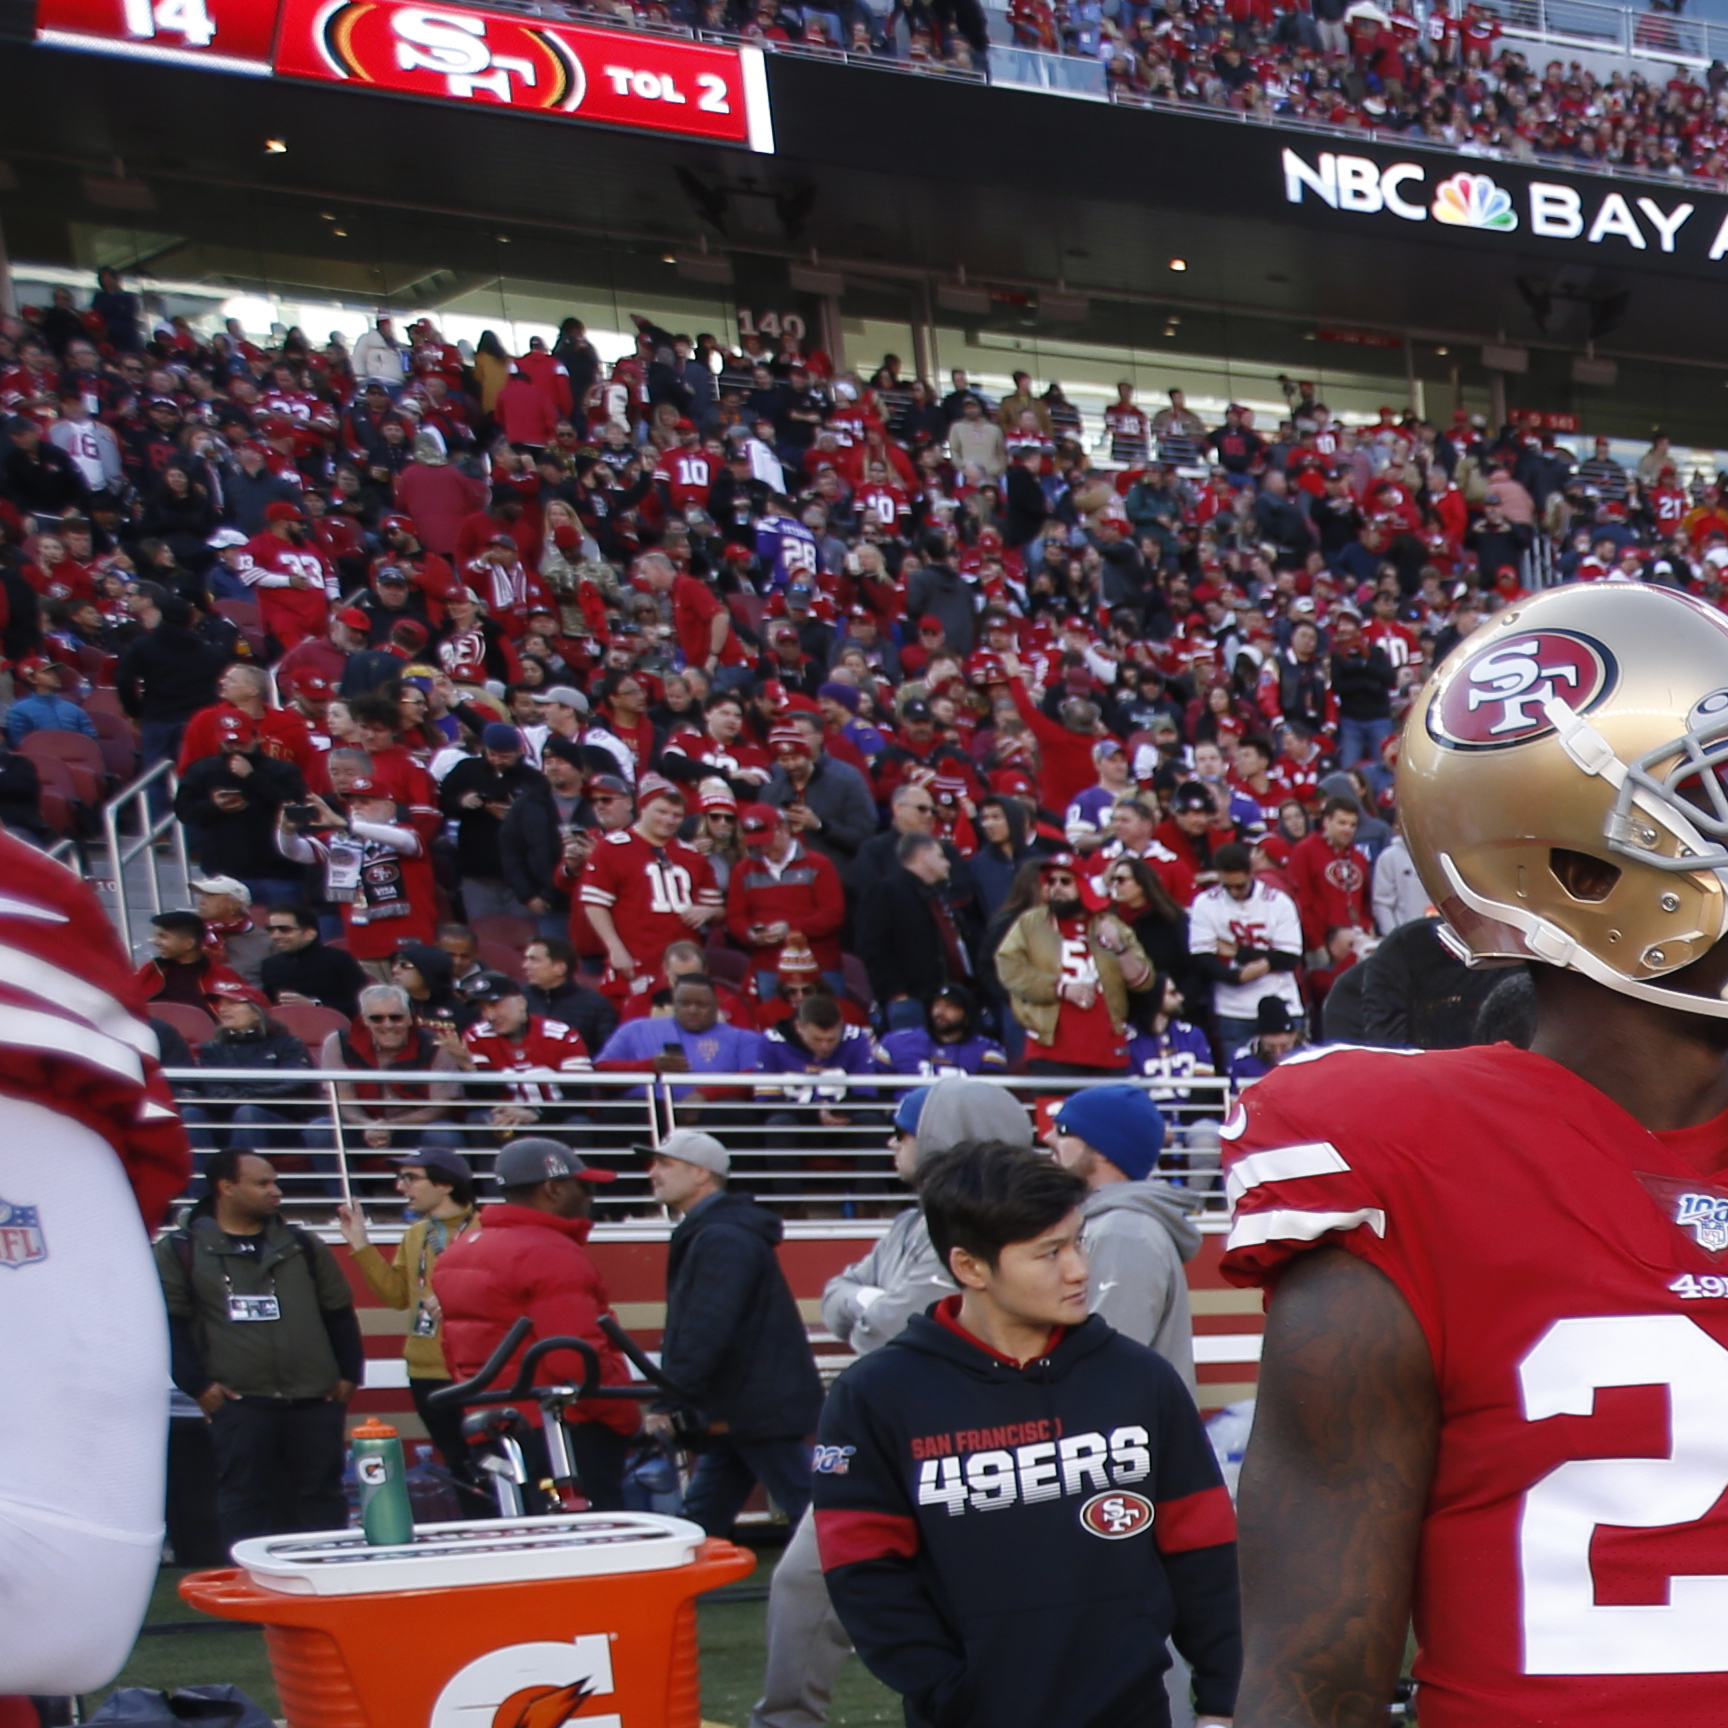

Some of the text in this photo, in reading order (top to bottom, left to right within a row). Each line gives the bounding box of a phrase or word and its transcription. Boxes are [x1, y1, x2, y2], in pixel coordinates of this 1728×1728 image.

[124, 0, 216, 46] 14
[605, 64, 730, 114] TOL 2
[1282, 146, 1427, 222] NBC
[1529, 181, 1694, 254] BAY
[738, 309, 806, 342] 140
[679, 459, 709, 487] 10
[1659, 496, 1682, 519] 21
[279, 552, 325, 589] 33
[782, 536, 817, 575] 28
[645, 862, 691, 913] 10
[0, 1227, 43, 1259] FL
[911, 1434, 954, 1460] SAN
[358, 1456, 387, 1486] G
[918, 1425, 1152, 1517] 49ERS
